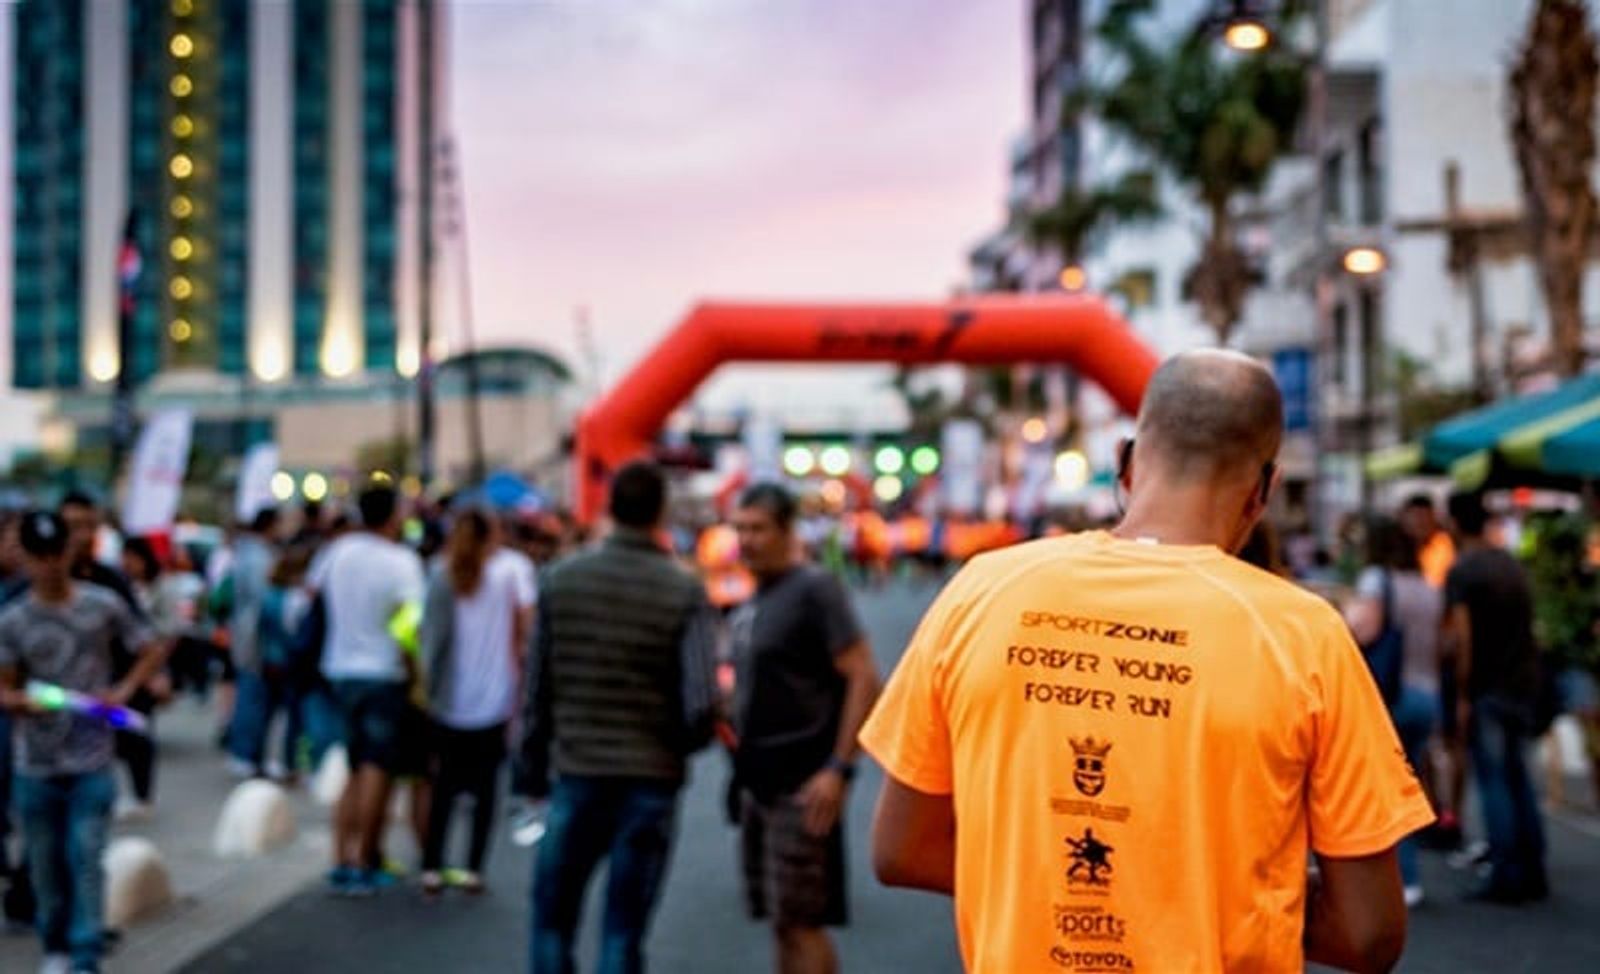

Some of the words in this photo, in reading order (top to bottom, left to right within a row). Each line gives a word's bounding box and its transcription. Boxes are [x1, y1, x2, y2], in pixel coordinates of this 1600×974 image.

[1020, 610, 1188, 646] SPORTZONE
[1007, 646, 1100, 672] FOREVER
[1113, 657, 1192, 685] YOUNG
[1025, 683, 1115, 711] FOREVER
[1127, 694, 1171, 718] RUN
[1073, 951, 1134, 969] TOYOTA
